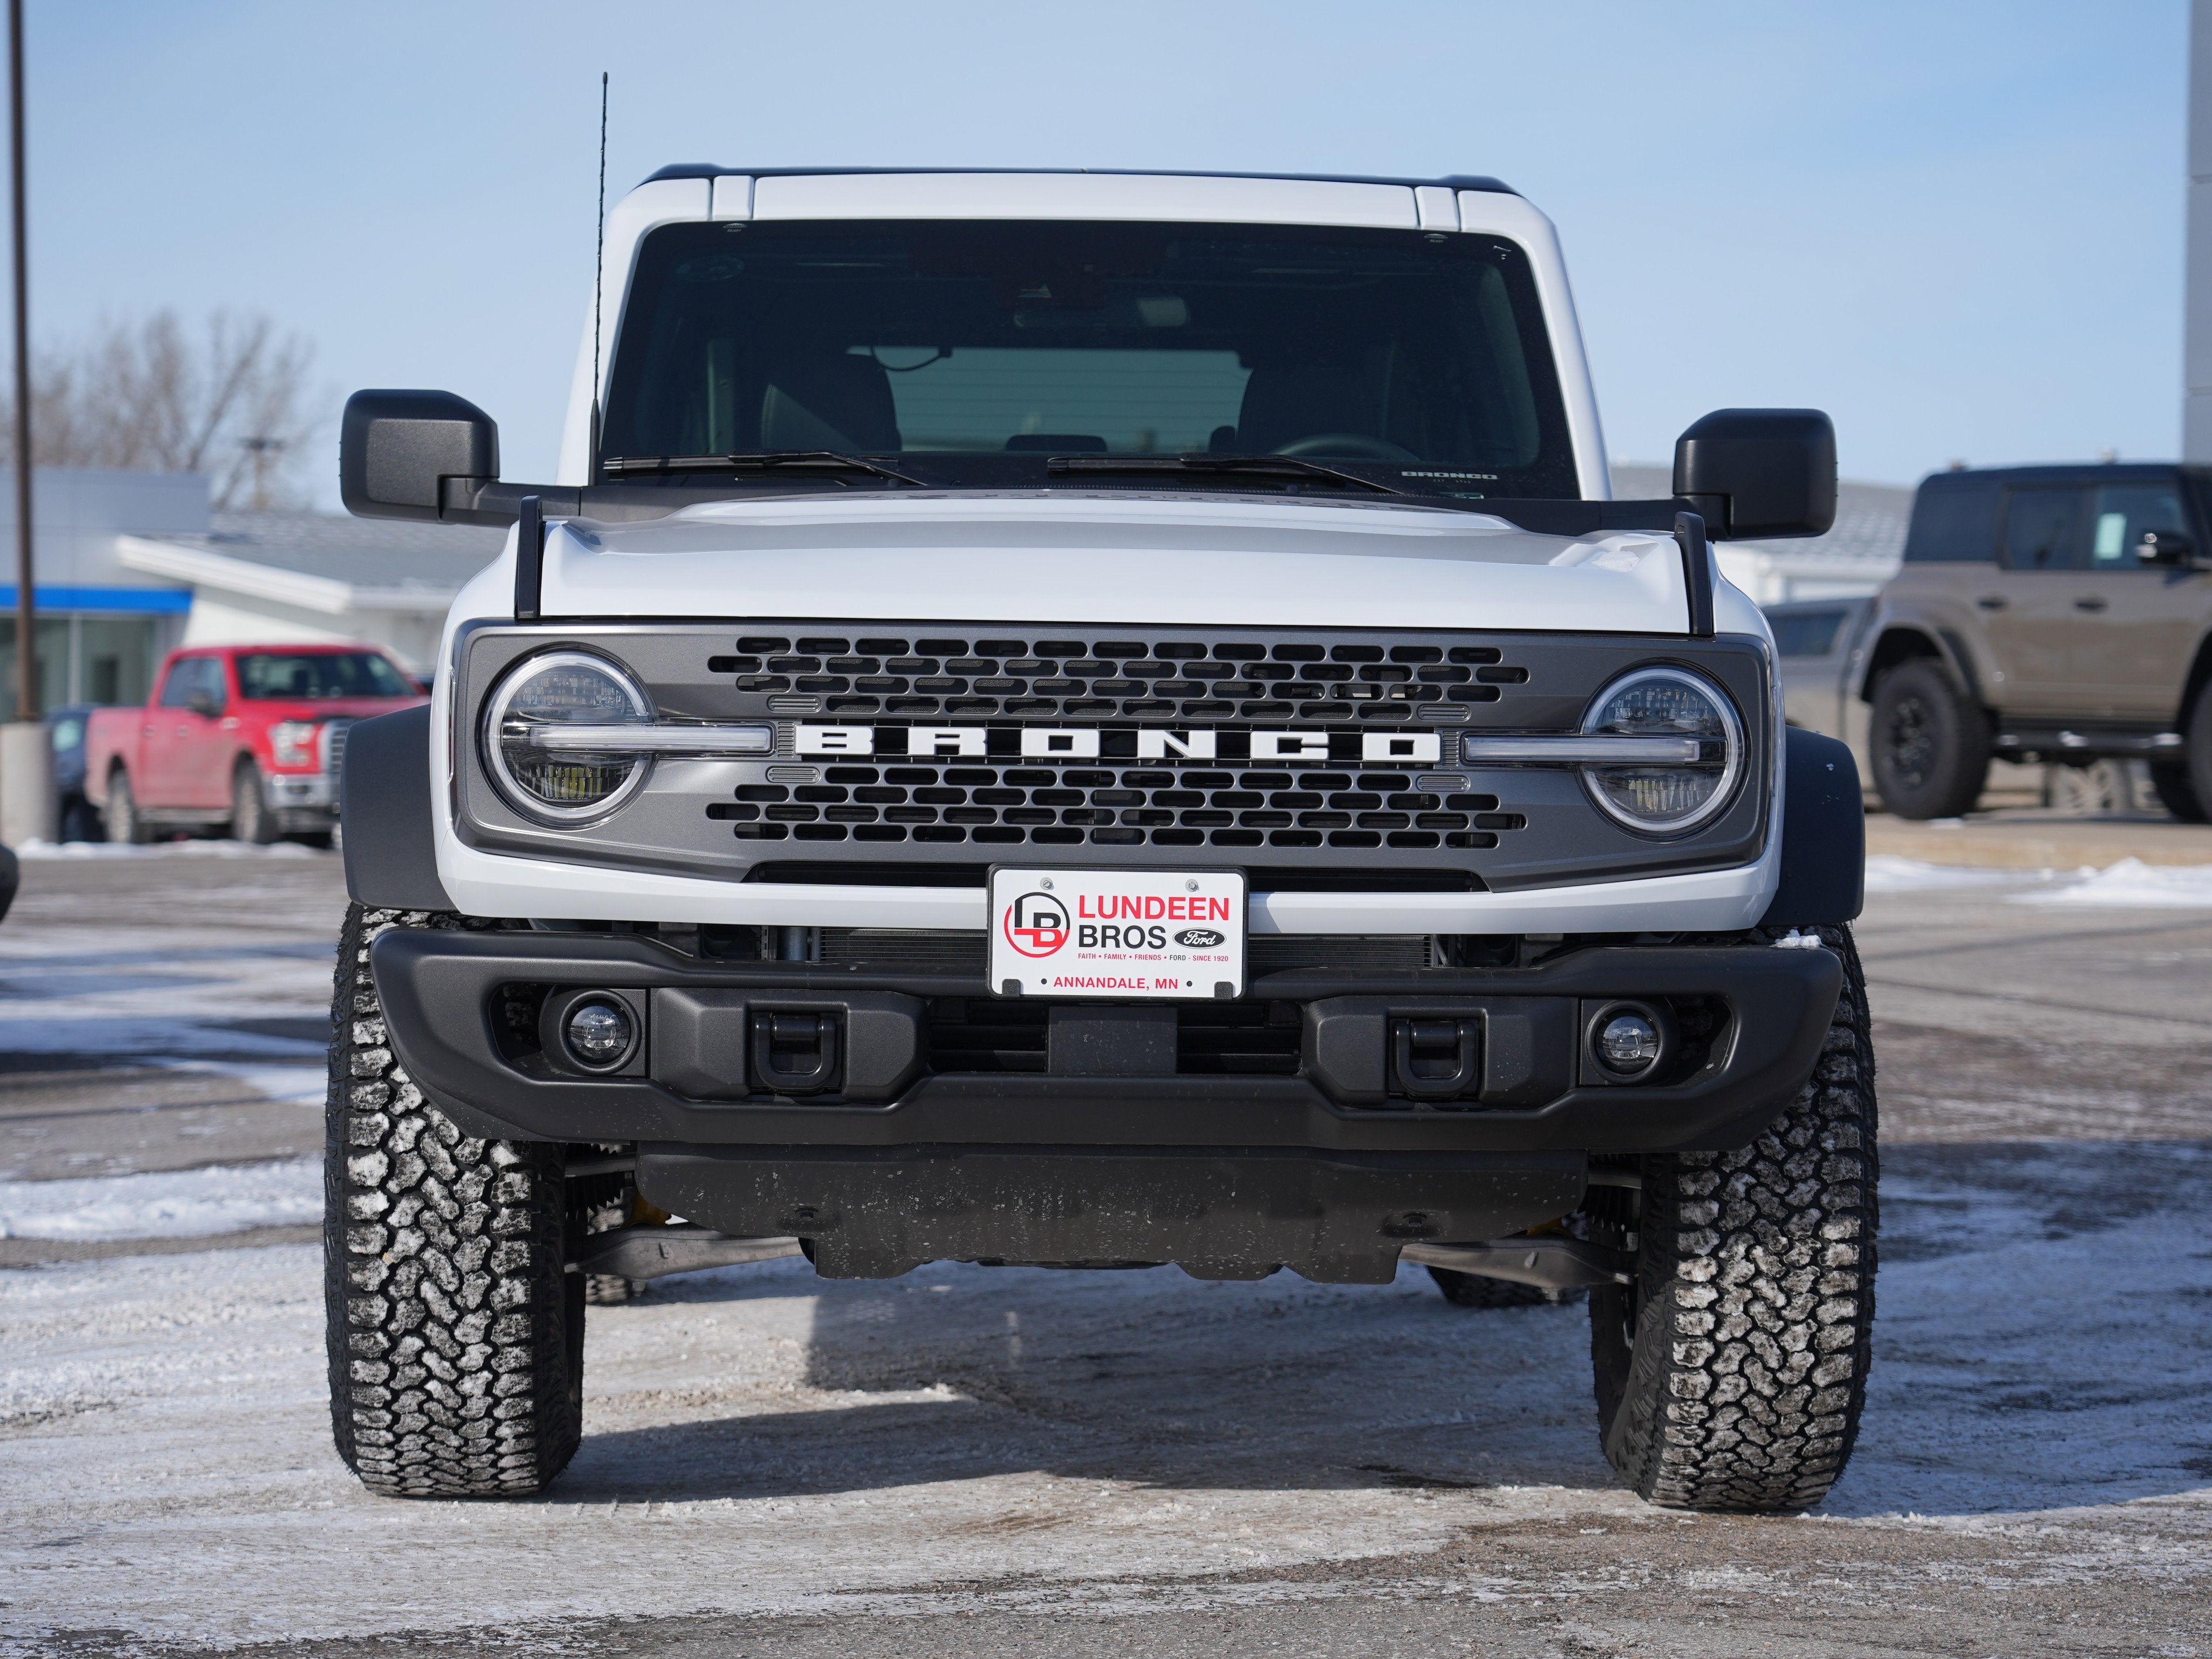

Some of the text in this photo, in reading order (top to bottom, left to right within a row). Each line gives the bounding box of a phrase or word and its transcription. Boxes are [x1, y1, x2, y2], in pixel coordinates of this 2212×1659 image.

[1401, 471, 1498, 480] BRONCO
[795, 724, 1441, 763] BRONCO
[1079, 895, 1229, 920] LUNDEEN
[1078, 925, 1166, 949] BROS
[1183, 930, 1217, 946] Ford
[1053, 976, 1178, 991] ANNANDALE, MN
